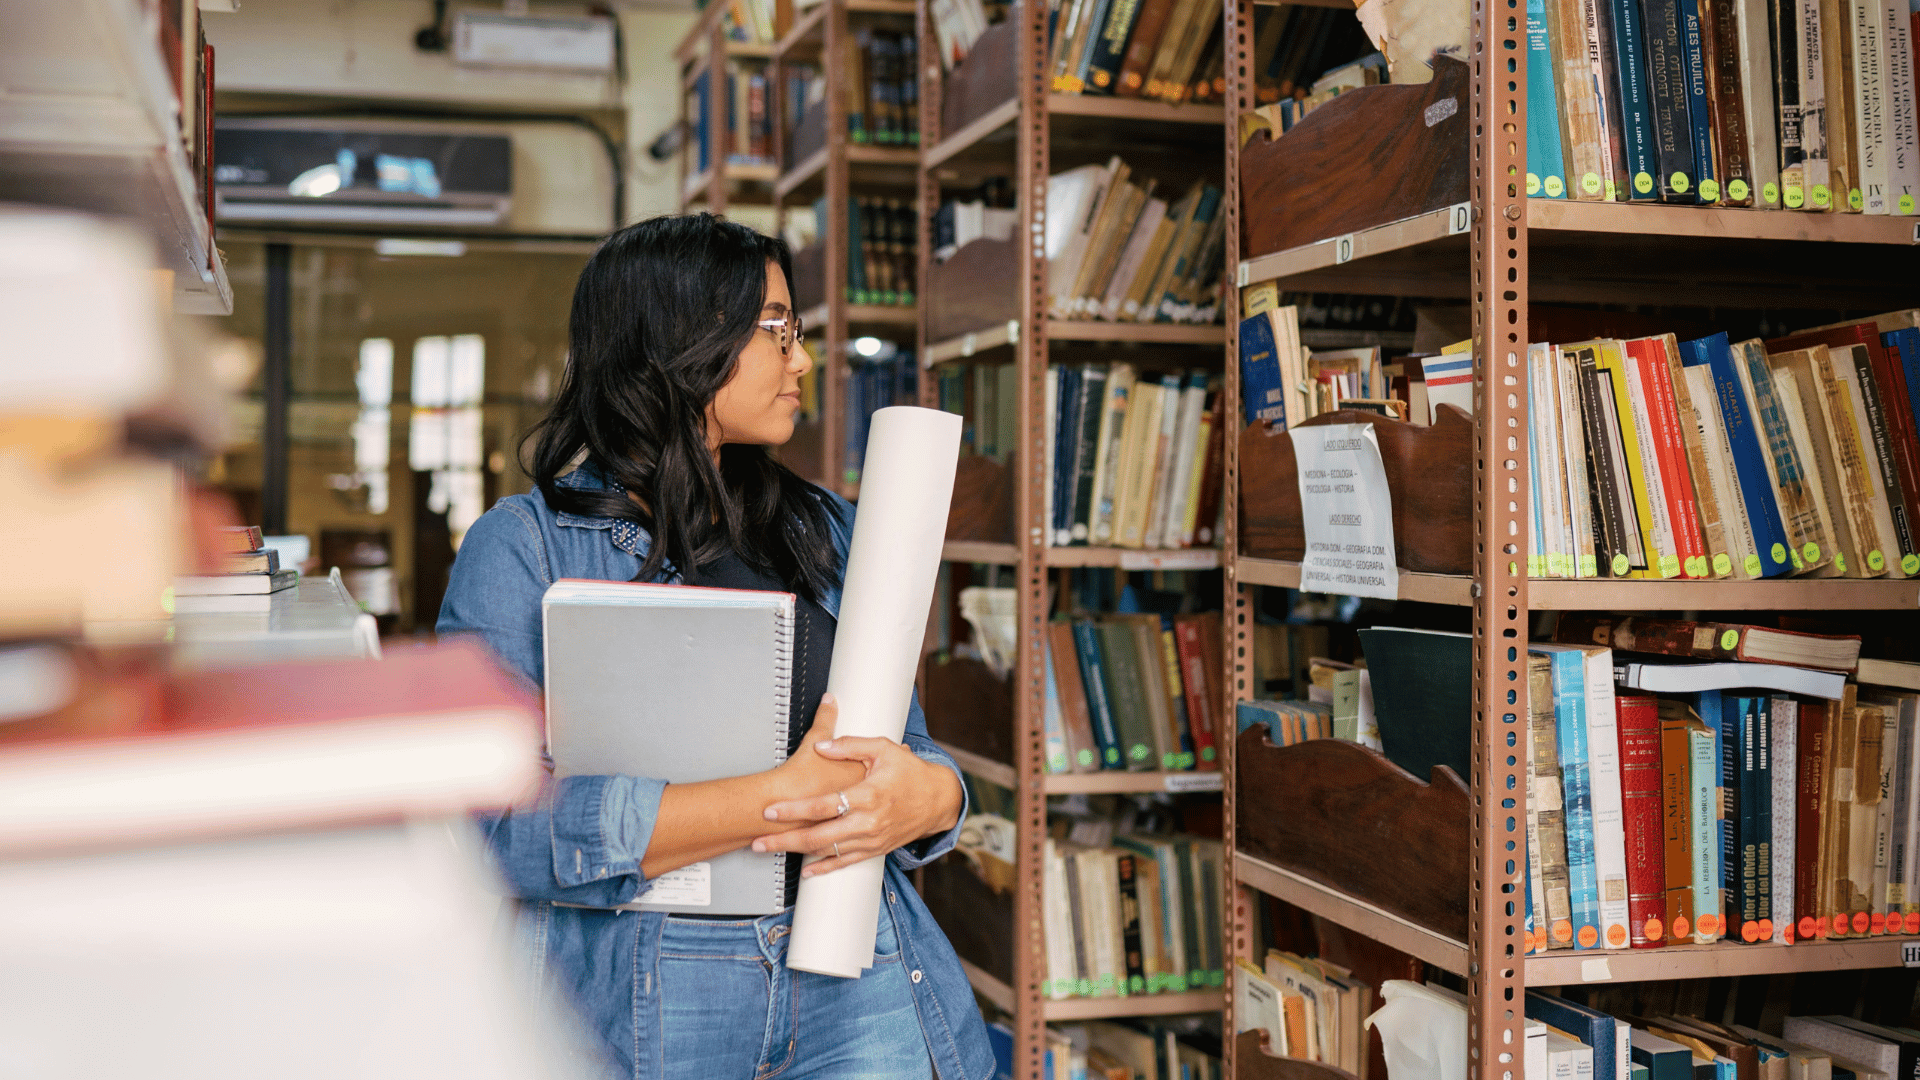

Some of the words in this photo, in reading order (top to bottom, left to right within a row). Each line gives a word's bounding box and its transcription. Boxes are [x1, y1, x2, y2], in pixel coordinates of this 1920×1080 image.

[1585, 0, 1595, 28] UMBARON
[1804, 3, 1810, 15] LA
[1811, 9, 1817, 19] EL
[1858, 6, 1866, 32] DEL
[1888, 8, 1896, 34] DEL
[1624, 10, 1632, 37] HOMBRE
[1664, 1, 1678, 46] MOLINA
[1687, 14, 1698, 31] ASI
[1589, 39, 1599, 63] JEFE
[1628, 45, 1633, 53] SU
[1688, 32, 1699, 46] ES
[1805, 17, 1815, 80] INTERVENCION
[1812, 22, 1820, 60] IMPACTO
[1860, 36, 1870, 86] PUEBLO
[1868, 26, 1878, 84] HISTORIA
[1890, 38, 1900, 88] PUEBLO
[1899, 28, 1909, 84] HISTORIA
[1629, 54, 1639, 103] PERSONALIDAD
[1653, 38, 1669, 98] LEONIDAS
[1690, 47, 1704, 96] TRUJILLO
[1669, 54, 1685, 112] TRUJILLO
[1661, 106, 1675, 152] RAFAEL
[1863, 89, 1874, 168] DOMINICANO
[1872, 87, 1882, 148] GENERAL
[1893, 91, 1905, 169] DOMINICANO
[1903, 88, 1913, 150] GENERAL
[1637, 145, 1643, 153] A.
[1869, 184, 1882, 197] IV
[1458, 206, 1468, 231] D
[1341, 246, 1350, 262] D
[1720, 382, 1729, 411] OTROS
[1727, 413, 1736, 439] TEMAS
[1726, 382, 1741, 427] DUARTE
[1324, 440, 1336, 449] LADO
[1337, 438, 1362, 448] IZQUIERDO
[1331, 469, 1354, 479] ECOLOGIA
[1306, 484, 1332, 494] PSICOLOGIA
[1334, 484, 1355, 494] HISTORIA
[1329, 514, 1340, 525] LADO
[1341, 514, 1362, 525] DERECHO
[1739, 509, 1746, 518] LA
[1310, 541, 1329, 552] HISTORIA
[1345, 544, 1372, 555] GEOGRAFIA
[1312, 557, 1333, 567] CIENCIAS
[1332, 558, 1353, 569] SOCIALES
[1355, 560, 1385, 571] GEOGRAFIA
[1306, 571, 1332, 582] UNIVERSAL
[1336, 574, 1357, 584] HISTORIA
[1357, 575, 1386, 587] UNIVERSAL
[1813, 732, 1822, 752] Una
[1811, 755, 1821, 795] Gestapo
[1700, 786, 1708, 826] BAHORUCO
[1811, 798, 1818, 811] en
[1669, 821, 1678, 841] Las
[1743, 844, 1755, 877] Olvido
[1758, 842, 1769, 875] Olvido
[1703, 885, 1709, 894] LA
[1743, 878, 1755, 896] del
[1758, 876, 1768, 894] del
[1743, 897, 1755, 920] Olor
[1758, 895, 1768, 917] Olor
